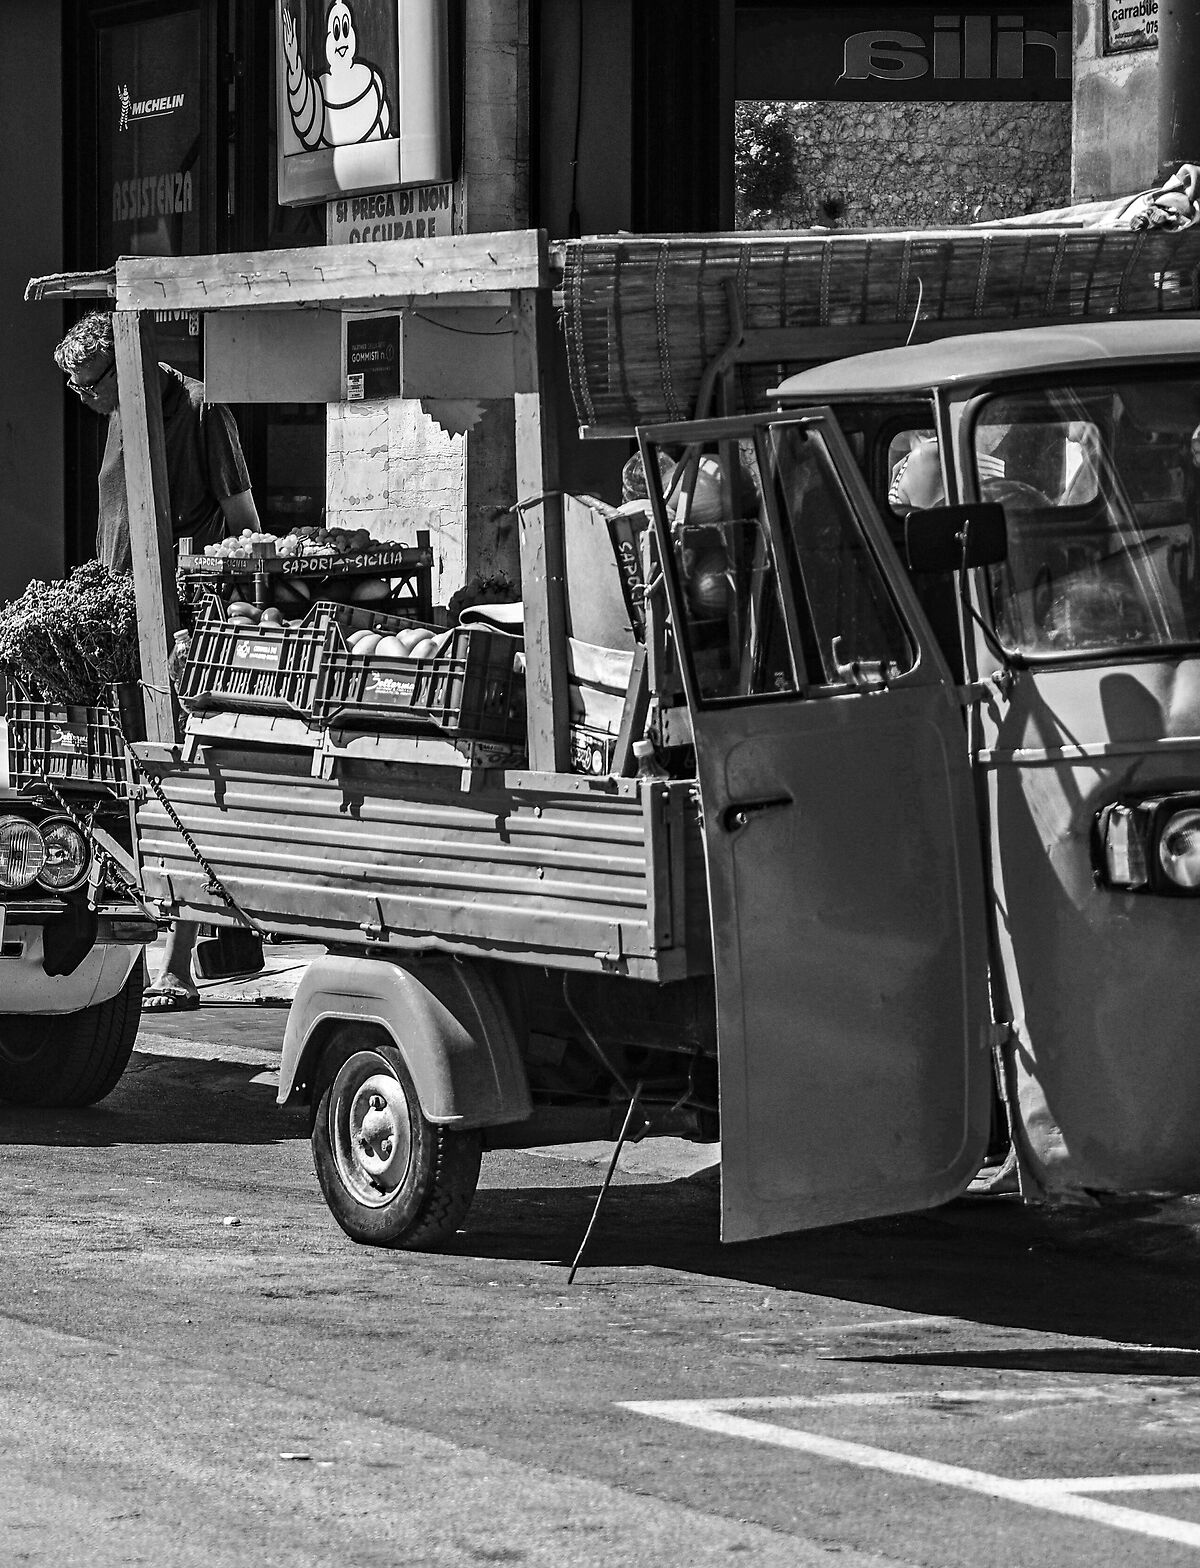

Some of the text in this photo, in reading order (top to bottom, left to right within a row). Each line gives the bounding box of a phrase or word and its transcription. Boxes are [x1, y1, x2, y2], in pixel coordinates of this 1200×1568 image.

[1145, 20, 1159, 34] 075
[131, 93, 185, 116] MICHELIN
[112, 170, 193, 222] ASSISTENZA
[336, 200, 348, 223] SI
[351, 194, 396, 222] PREGA
[400, 190, 414, 216] DI
[418, 185, 449, 212] NON
[349, 217, 436, 244] OCCUPARE
[351, 350, 380, 363] GOMMISTI
[194, 557, 218, 567] SAPORI
[282, 559, 333, 575] SAPORI
[354, 552, 404, 568] SICILIA
